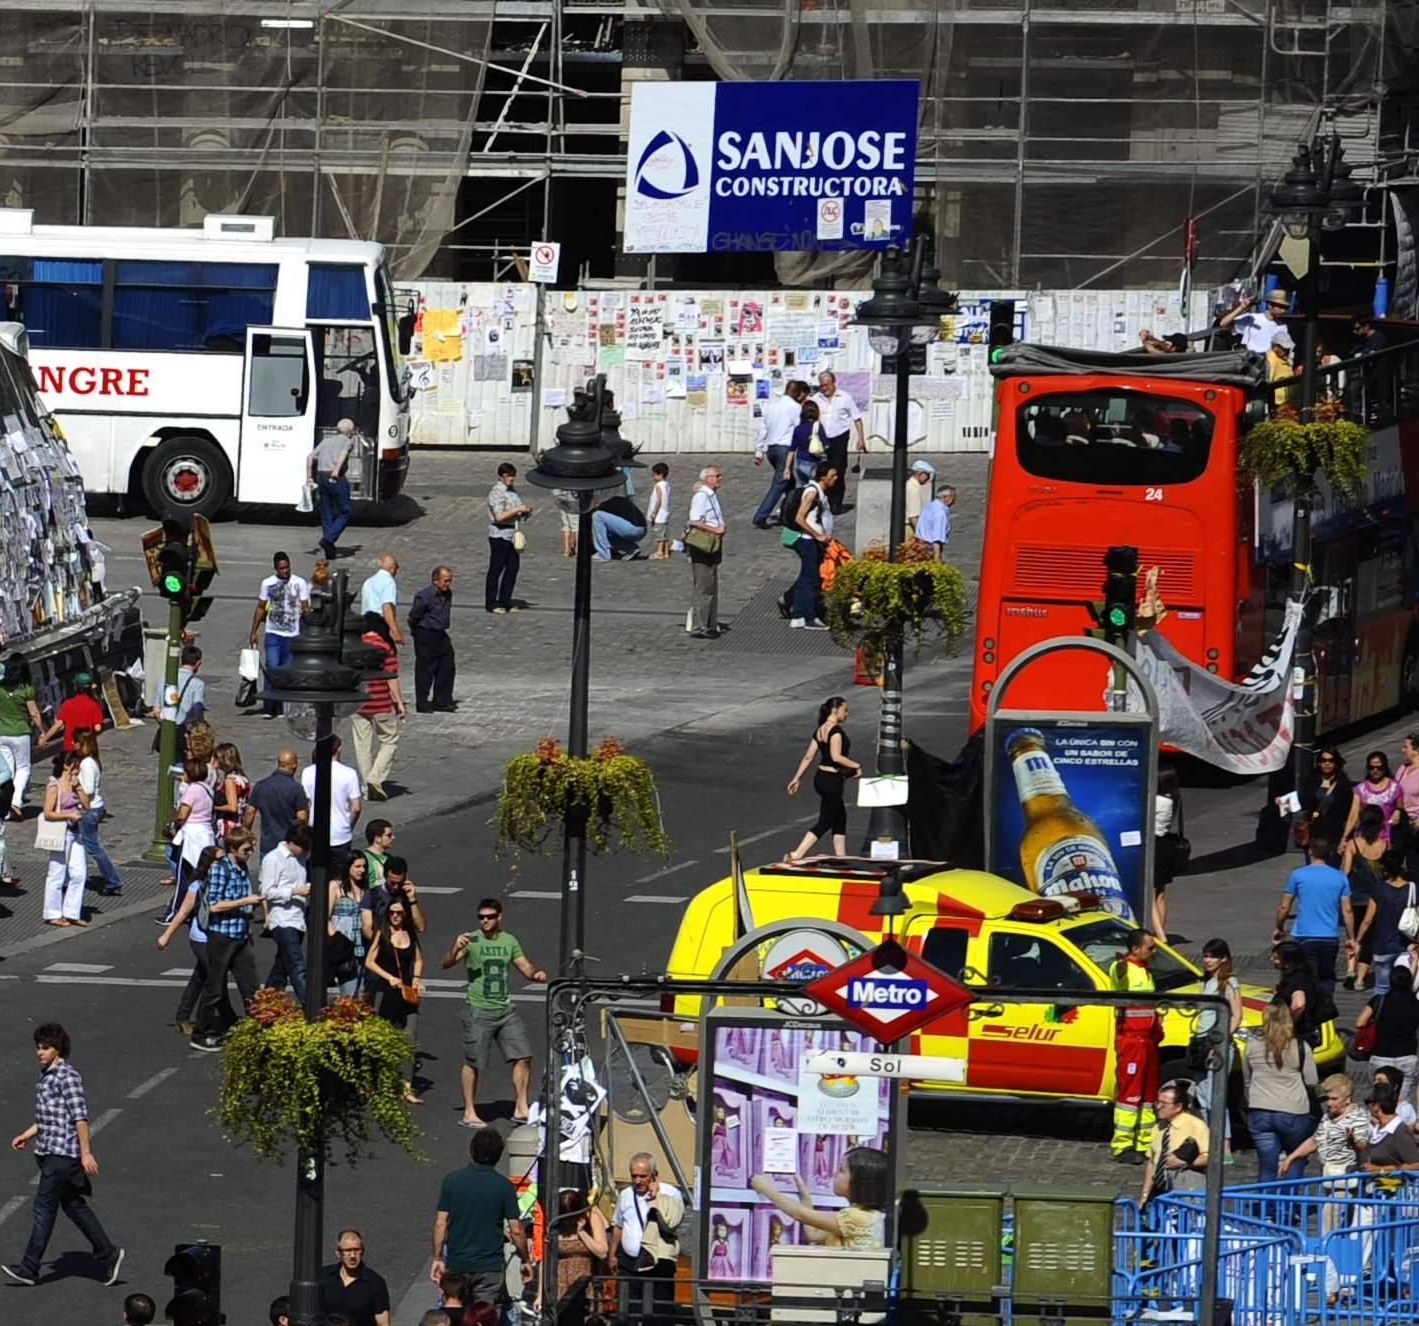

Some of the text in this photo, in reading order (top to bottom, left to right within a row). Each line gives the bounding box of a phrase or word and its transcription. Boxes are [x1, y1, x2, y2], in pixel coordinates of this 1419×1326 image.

[717, 130, 906, 171] SANJOSE
[716, 176, 904, 198] CONSTRUCTORA
[30, 366, 150, 397] NGRE
[1145, 488, 1164, 501] 24
[1055, 738, 1067, 746] LA
[1053, 757, 1139, 767] CINCO ESTRELLAS
[1064, 749, 1127, 758] UN SABOR DE
[482, 958, 507, 999] 8
[852, 981, 922, 1006] Metro
[869, 1057, 902, 1074] Sol
